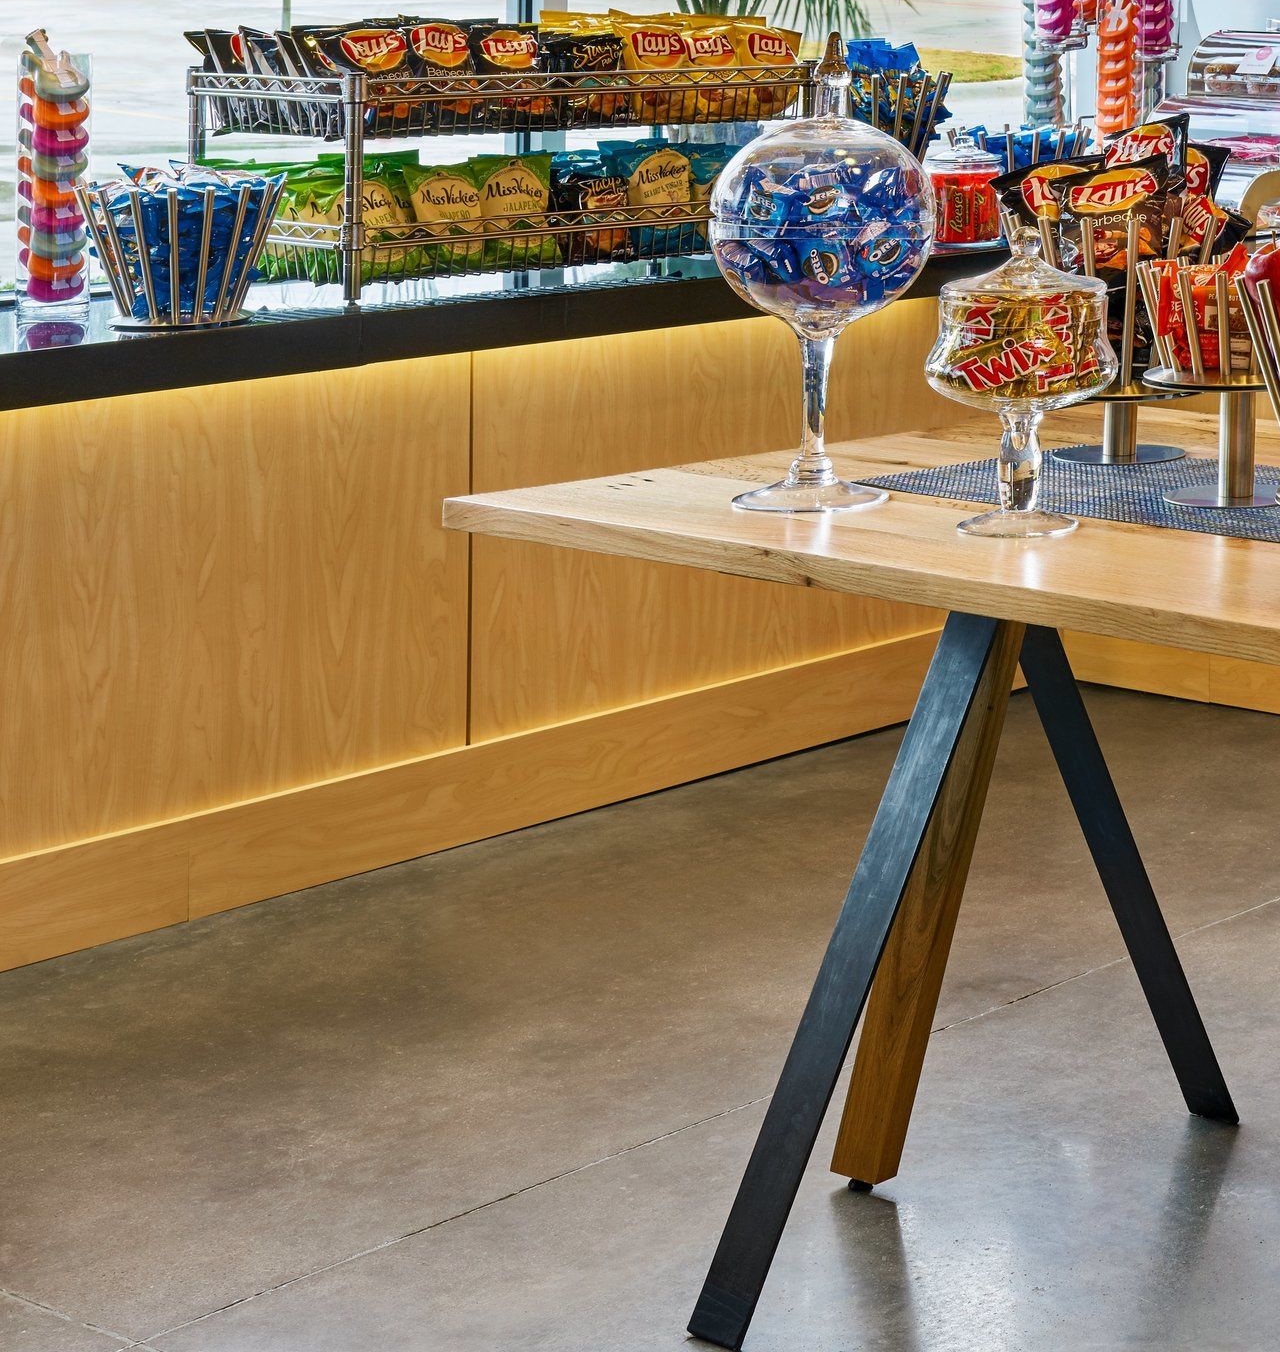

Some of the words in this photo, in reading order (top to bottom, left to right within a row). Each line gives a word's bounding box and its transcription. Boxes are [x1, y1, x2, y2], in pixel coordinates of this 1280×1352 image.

[417, 27, 467, 54] Lay's
[636, 33, 680, 56] Lay's
[689, 36, 732, 59] Lay's
[420, 189, 446, 205] Miss
[440, 186, 480, 208] Vickie's
[485, 182, 516, 201] Miss
[1077, 178, 1152, 206] Lay's
[1092, 212, 1147, 228] arbecue
[868, 238, 900, 263] ORE
[810, 248, 829, 285] OREO
